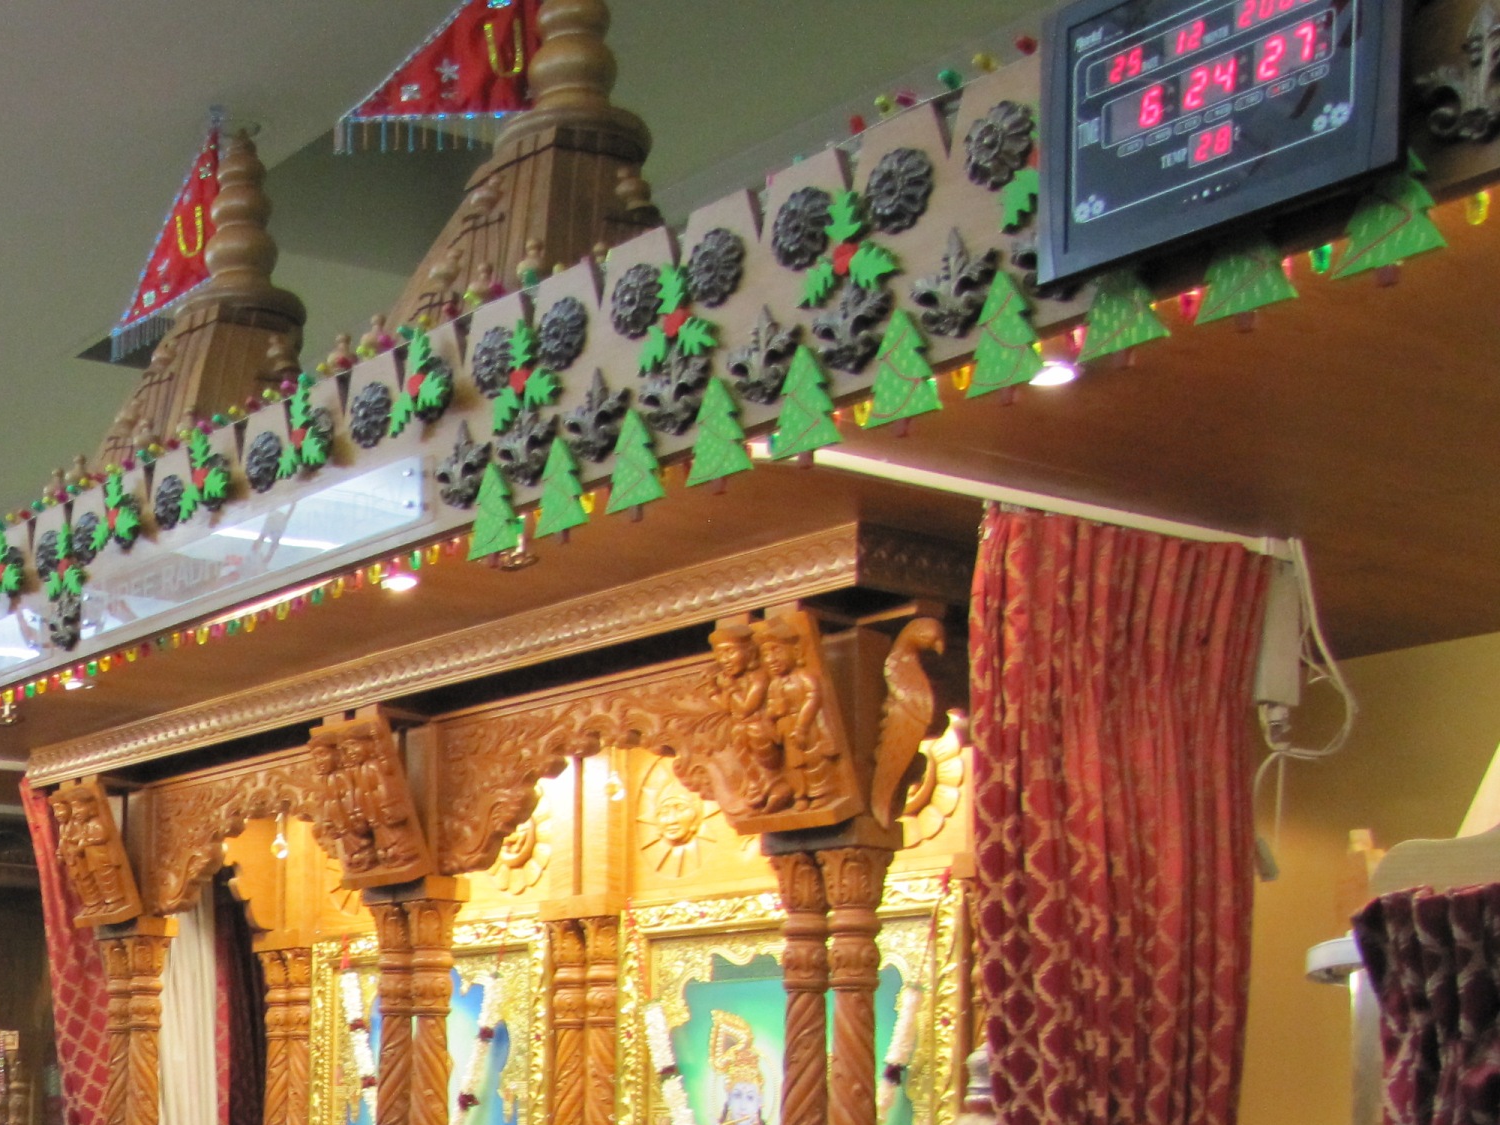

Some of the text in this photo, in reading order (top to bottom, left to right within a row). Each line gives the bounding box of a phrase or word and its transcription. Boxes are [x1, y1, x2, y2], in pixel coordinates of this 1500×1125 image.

[1108, 48, 1143, 84] 25
[1175, 20, 1205, 55] 12
[1138, 84, 1164, 128] 6
[1182, 57, 1238, 111] 24
[1255, 21, 1317, 80] 27
[1193, 124, 1232, 162] 28
